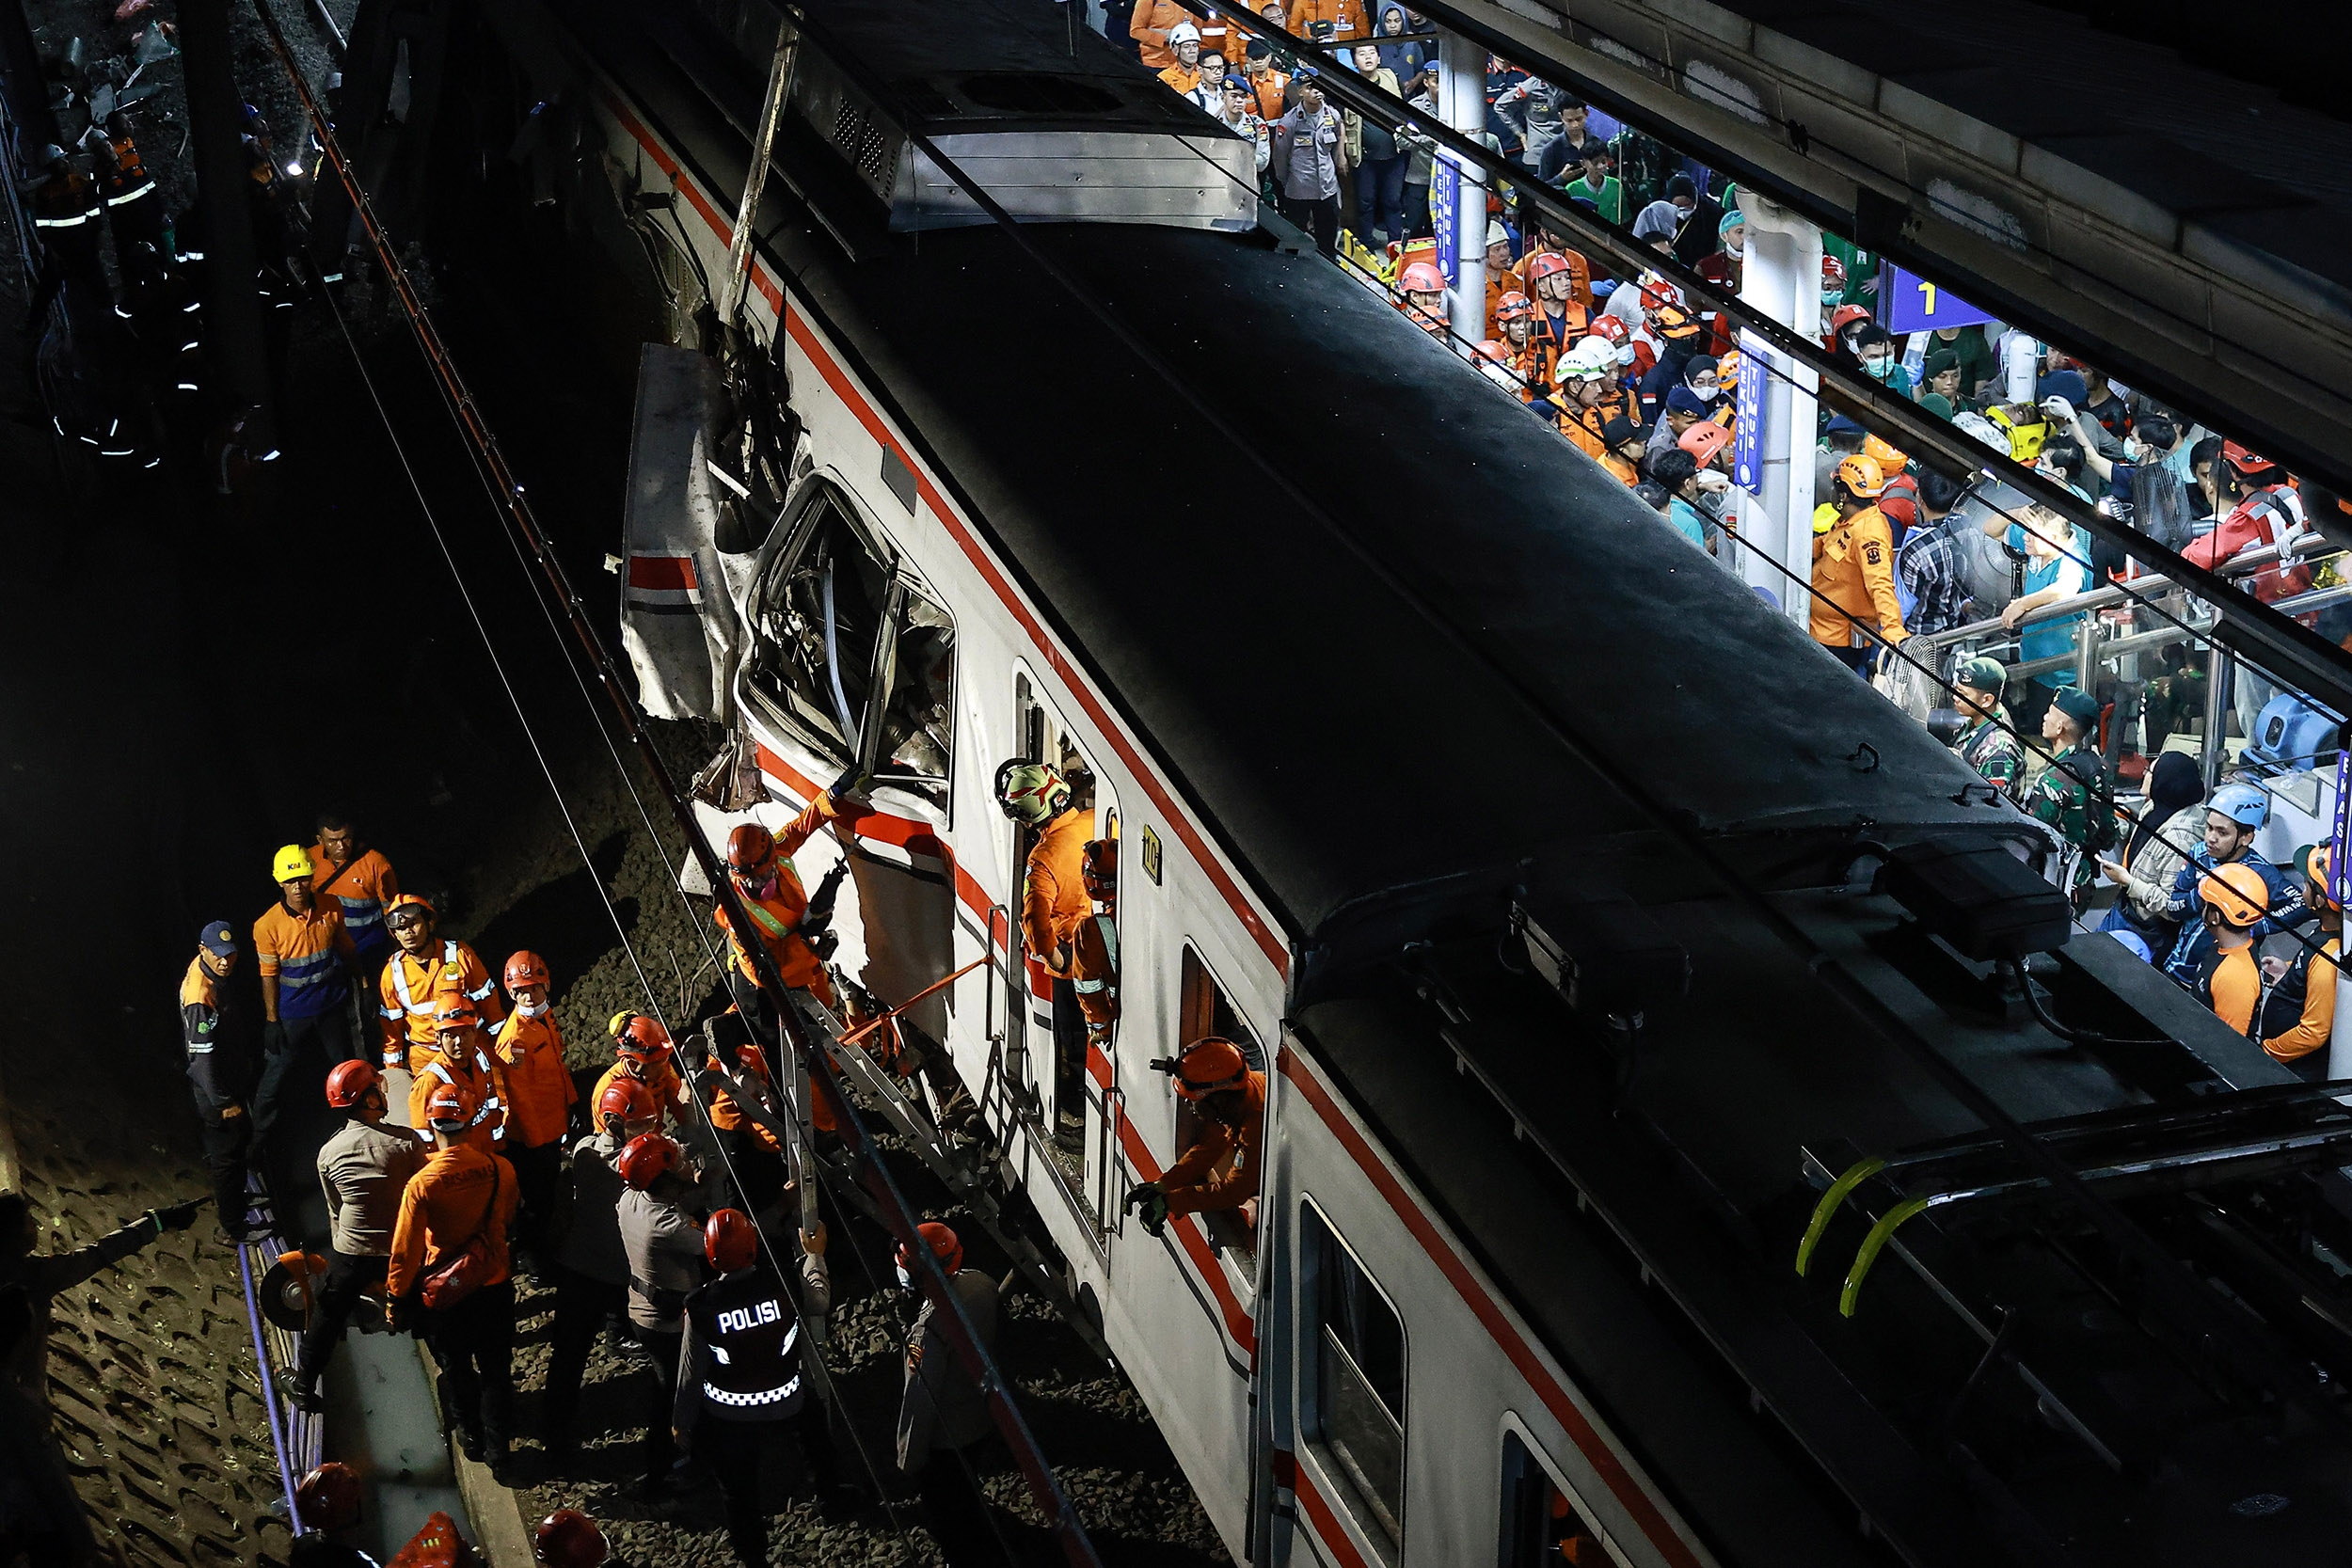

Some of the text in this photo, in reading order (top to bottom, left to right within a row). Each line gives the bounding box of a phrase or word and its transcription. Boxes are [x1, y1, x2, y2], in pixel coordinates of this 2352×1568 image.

[1918, 281, 1936, 315] 1
[1738, 351, 1748, 452] BEKASI
[1748, 367, 1758, 451] TIMUR
[2335, 756, 2349, 860] EKASI
[1146, 835, 1156, 870] 10
[718, 1299, 782, 1334] POLISI
